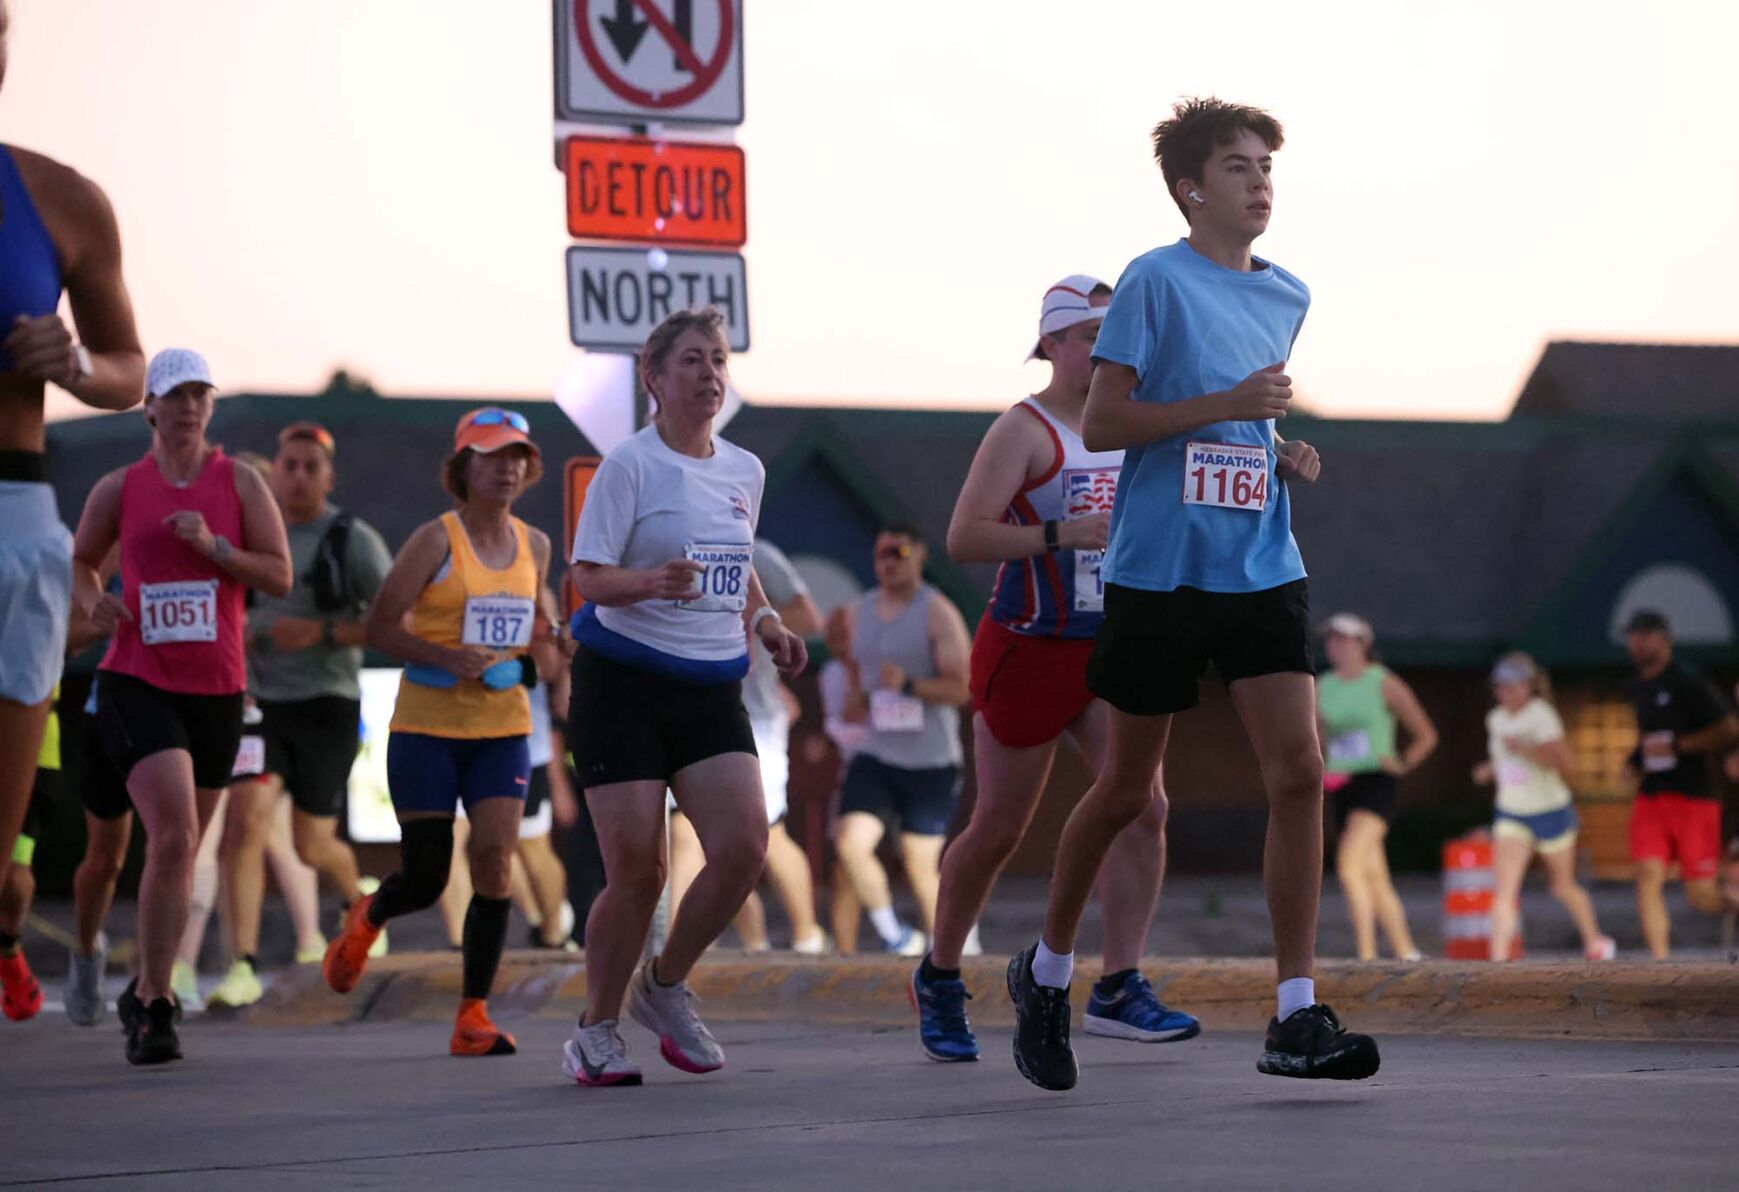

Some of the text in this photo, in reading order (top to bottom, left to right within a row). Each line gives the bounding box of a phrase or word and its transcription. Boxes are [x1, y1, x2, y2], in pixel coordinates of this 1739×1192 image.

[579, 160, 732, 222] DETOUR
[580, 269, 735, 327] NORTH
[1191, 466, 1266, 507] 1164
[692, 552, 750, 562] MARATHON
[1082, 554, 1104, 564] MA
[702, 565, 742, 596] 108
[145, 590, 211, 600] MARATHON
[146, 600, 208, 630] 1051
[471, 606, 529, 614] MARATHON
[477, 616, 522, 643] 187
